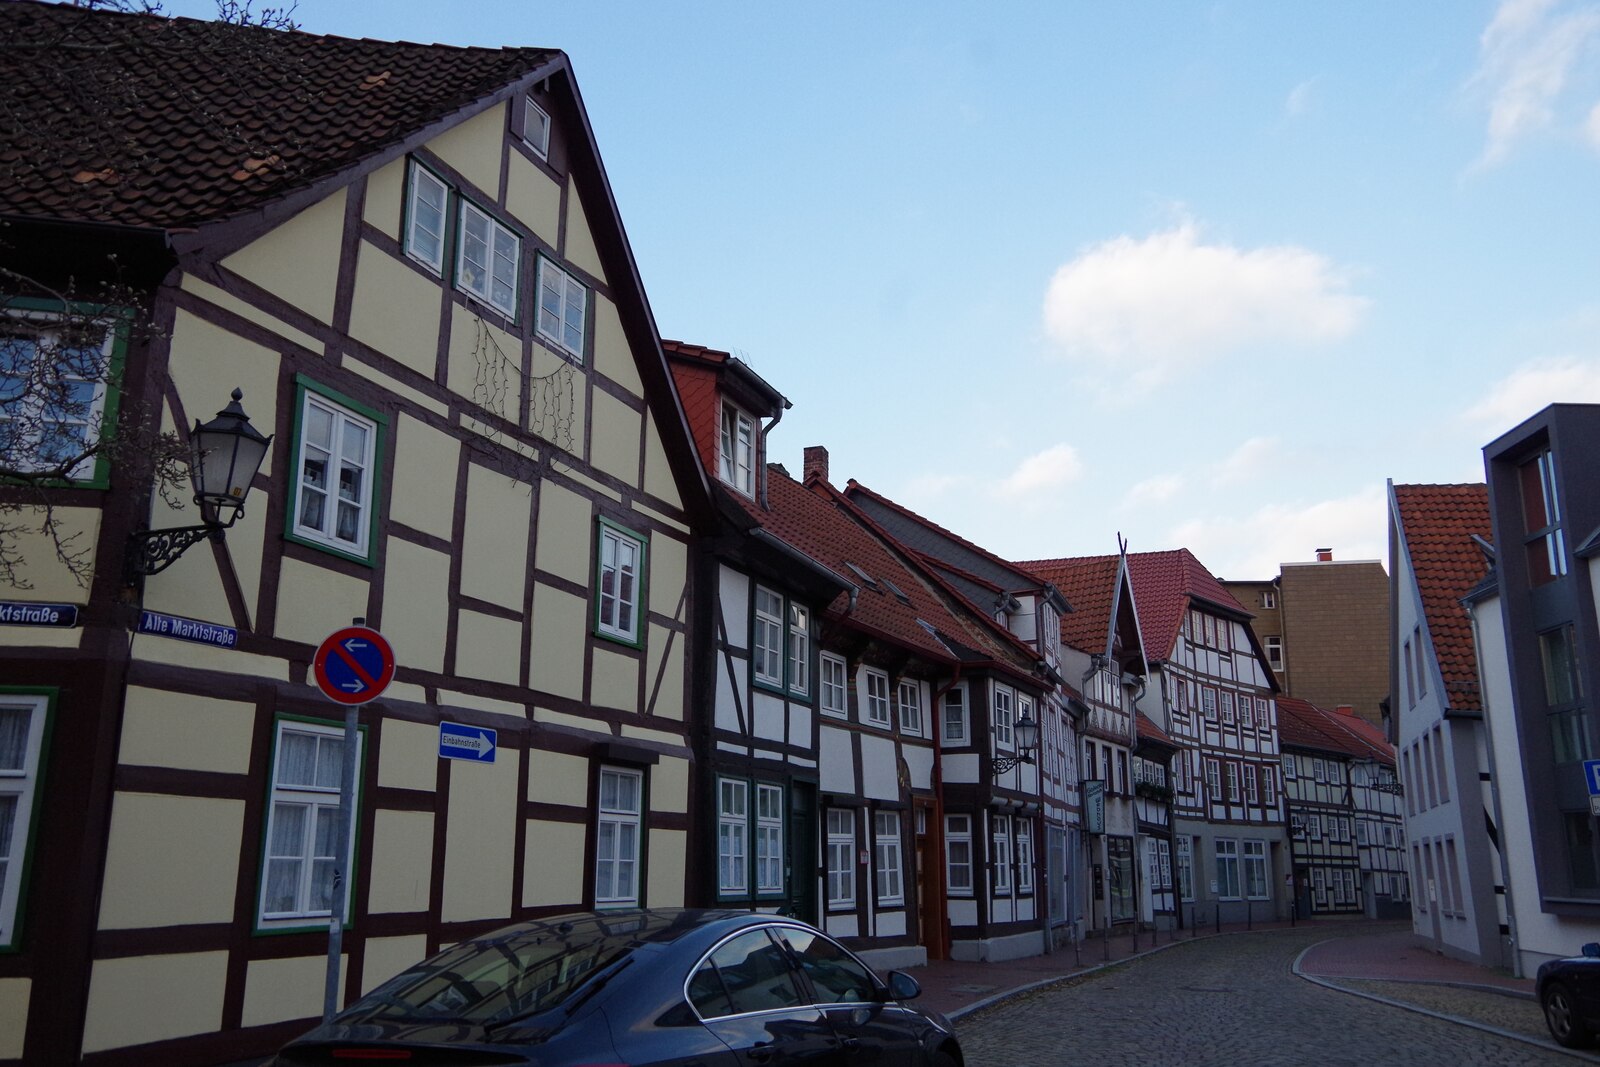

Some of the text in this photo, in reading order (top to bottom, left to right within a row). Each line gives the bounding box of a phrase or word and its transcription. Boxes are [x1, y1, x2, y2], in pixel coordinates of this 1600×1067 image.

[144, 614, 234, 645] Alte Marktstraße
[442, 735, 481, 749] Einbahnstraße
